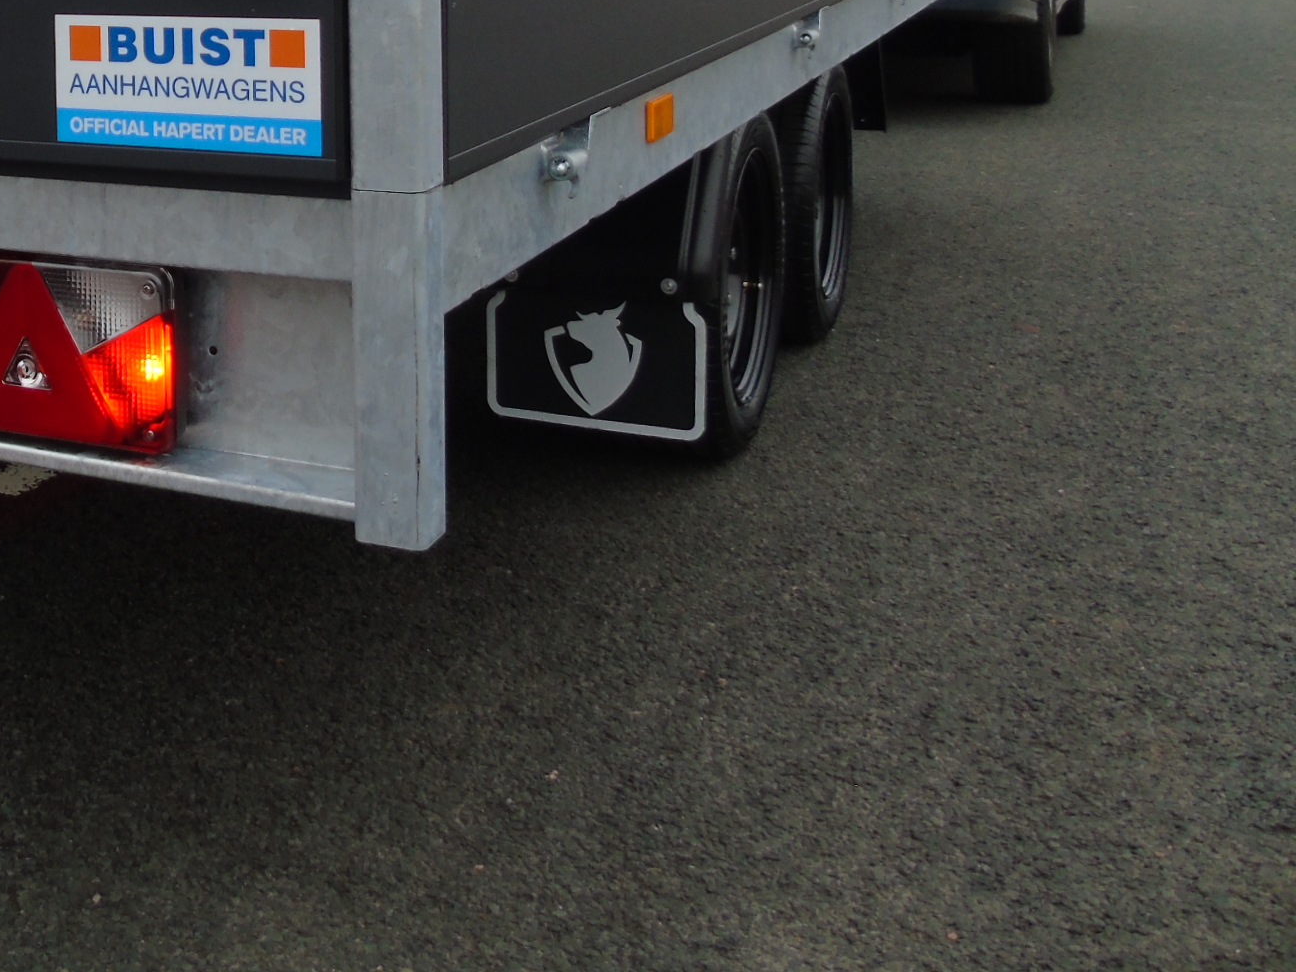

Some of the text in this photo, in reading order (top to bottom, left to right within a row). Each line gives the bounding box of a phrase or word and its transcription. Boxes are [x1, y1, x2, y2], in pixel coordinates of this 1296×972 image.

[108, 25, 265, 67] BUIST
[69, 73, 306, 104] AANHANGWAGENS
[70, 115, 306, 146] OFFICIAL HAPERT DEALER
